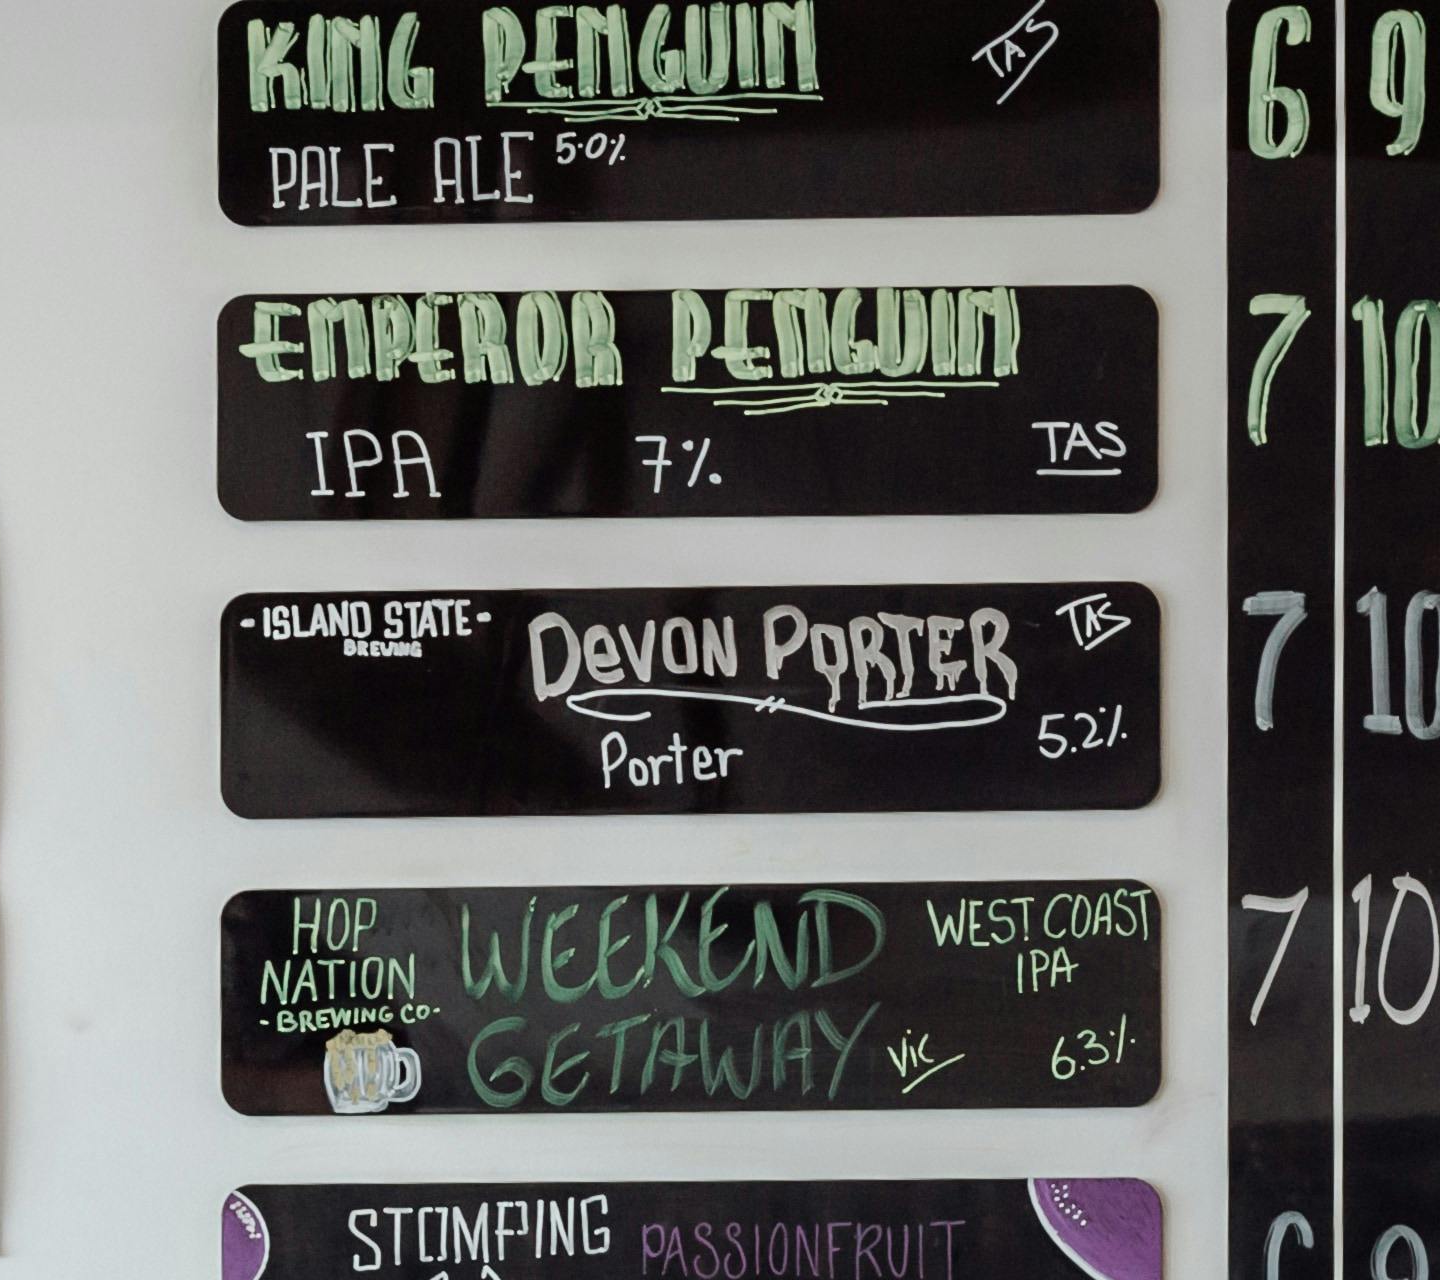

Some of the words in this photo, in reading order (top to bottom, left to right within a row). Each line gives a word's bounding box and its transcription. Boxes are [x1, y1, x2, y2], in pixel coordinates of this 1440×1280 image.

[247, 12, 434, 111] KING
[483, 3, 820, 102] PENGUIN
[1248, 6, 1311, 158] 6
[1370, 10, 1426, 156] 9
[269, 143, 396, 209] PALE
[434, 132, 534, 203] ALE
[238, 291, 623, 387] EMPEROR
[671, 286, 1020, 379] PENGUIN
[1248, 295, 1311, 446] 7
[306, 430, 441, 497] IPA
[635, 436, 721, 493] 7%
[1032, 420, 1128, 459] TAS
[764, 607, 1017, 710] PORTER
[600, 733, 743, 788] Porter
[293, 897, 377, 955] HOP
[460, 888, 885, 998] WEEKEND
[926, 896, 1036, 949] WEST
[1043, 886, 1151, 944] COAST
[260, 953, 415, 1004] NATION
[1015, 951, 1079, 993] IPA
[468, 1001, 881, 1107] GETAWAY
[348, 1194, 611, 1271] STOMPING
